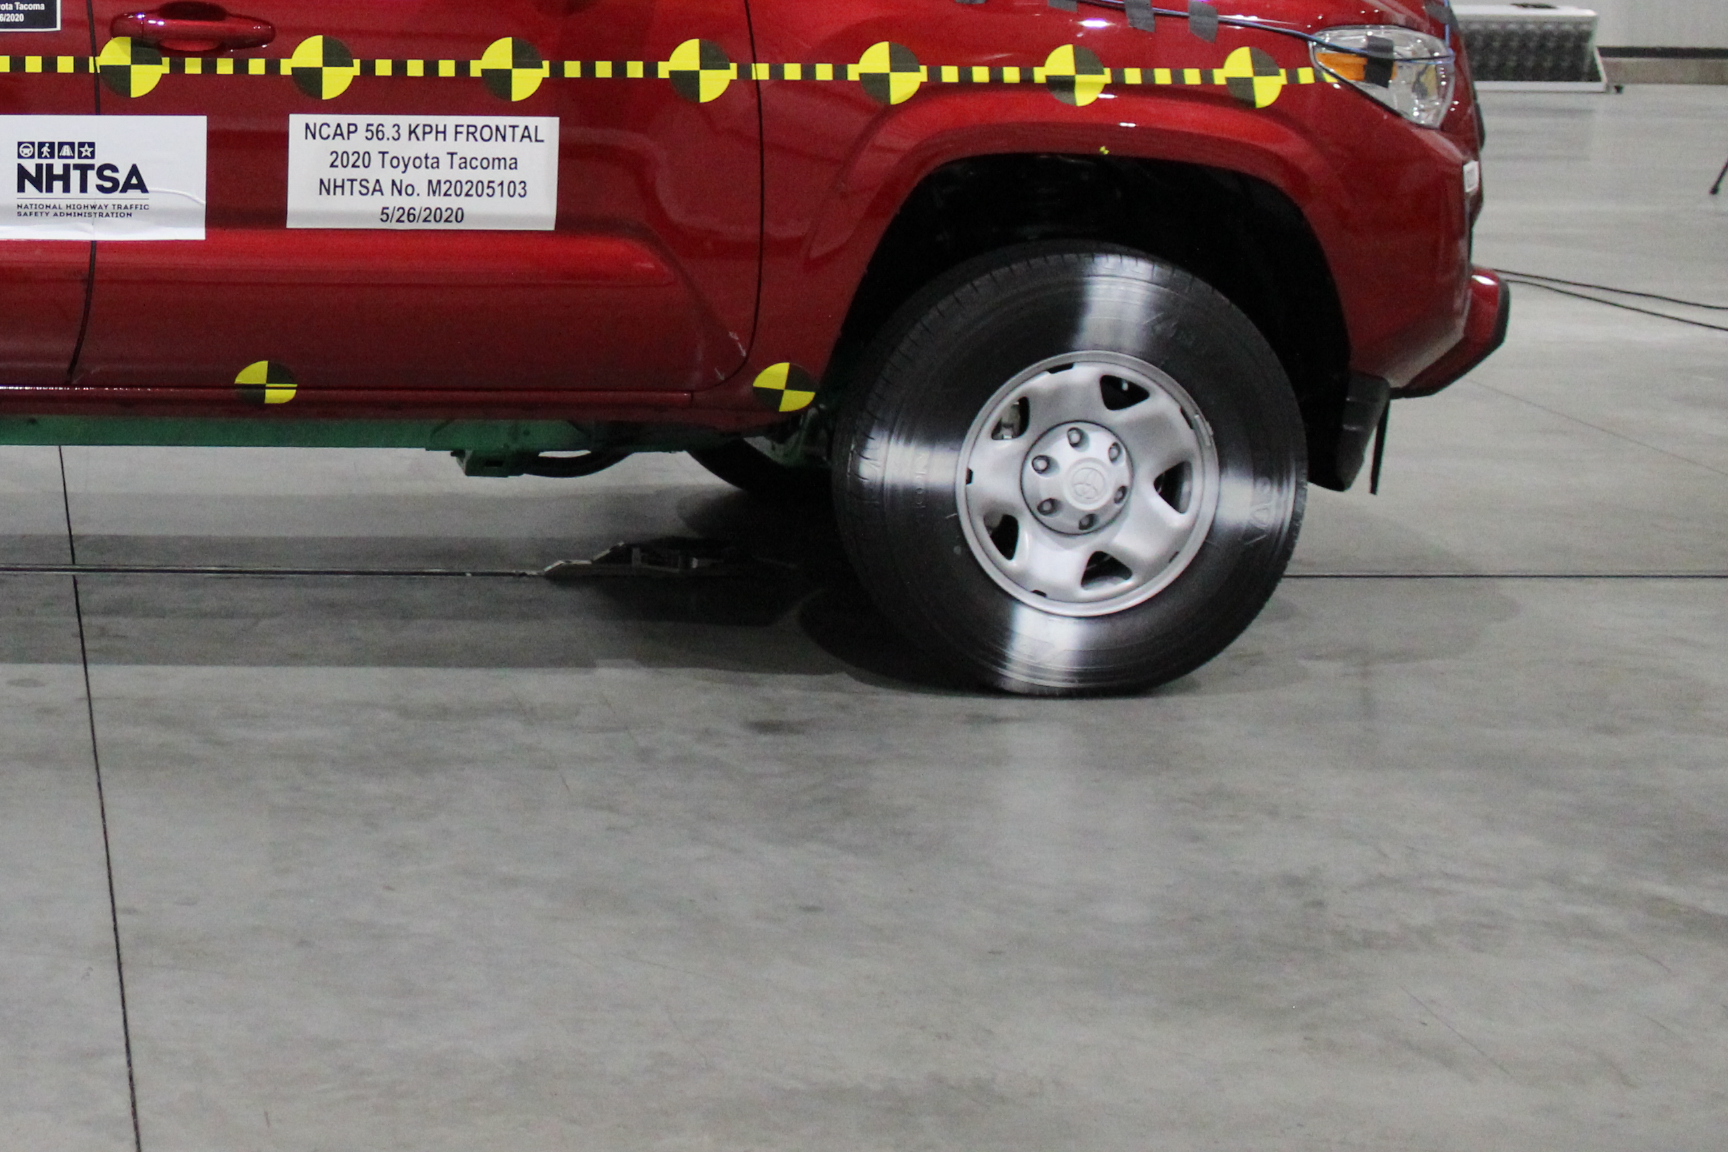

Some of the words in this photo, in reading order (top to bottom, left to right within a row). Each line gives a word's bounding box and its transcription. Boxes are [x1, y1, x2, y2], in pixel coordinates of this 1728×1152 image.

[15, 2, 45, 10] Tacoma
[305, 122, 359, 141] NCAP
[365, 123, 401, 142] 56.3
[408, 123, 447, 142] KPH
[453, 124, 545, 143] FRONTAL
[329, 151, 372, 169] 2020
[378, 151, 441, 173] Toyota
[447, 152, 518, 170] Tacoma
[17, 163, 149, 194] NHTSA
[318, 179, 384, 196] NHTSA
[391, 179, 421, 197] No.
[427, 180, 527, 198] M20205103
[379, 206, 464, 224] 5/26/2020
